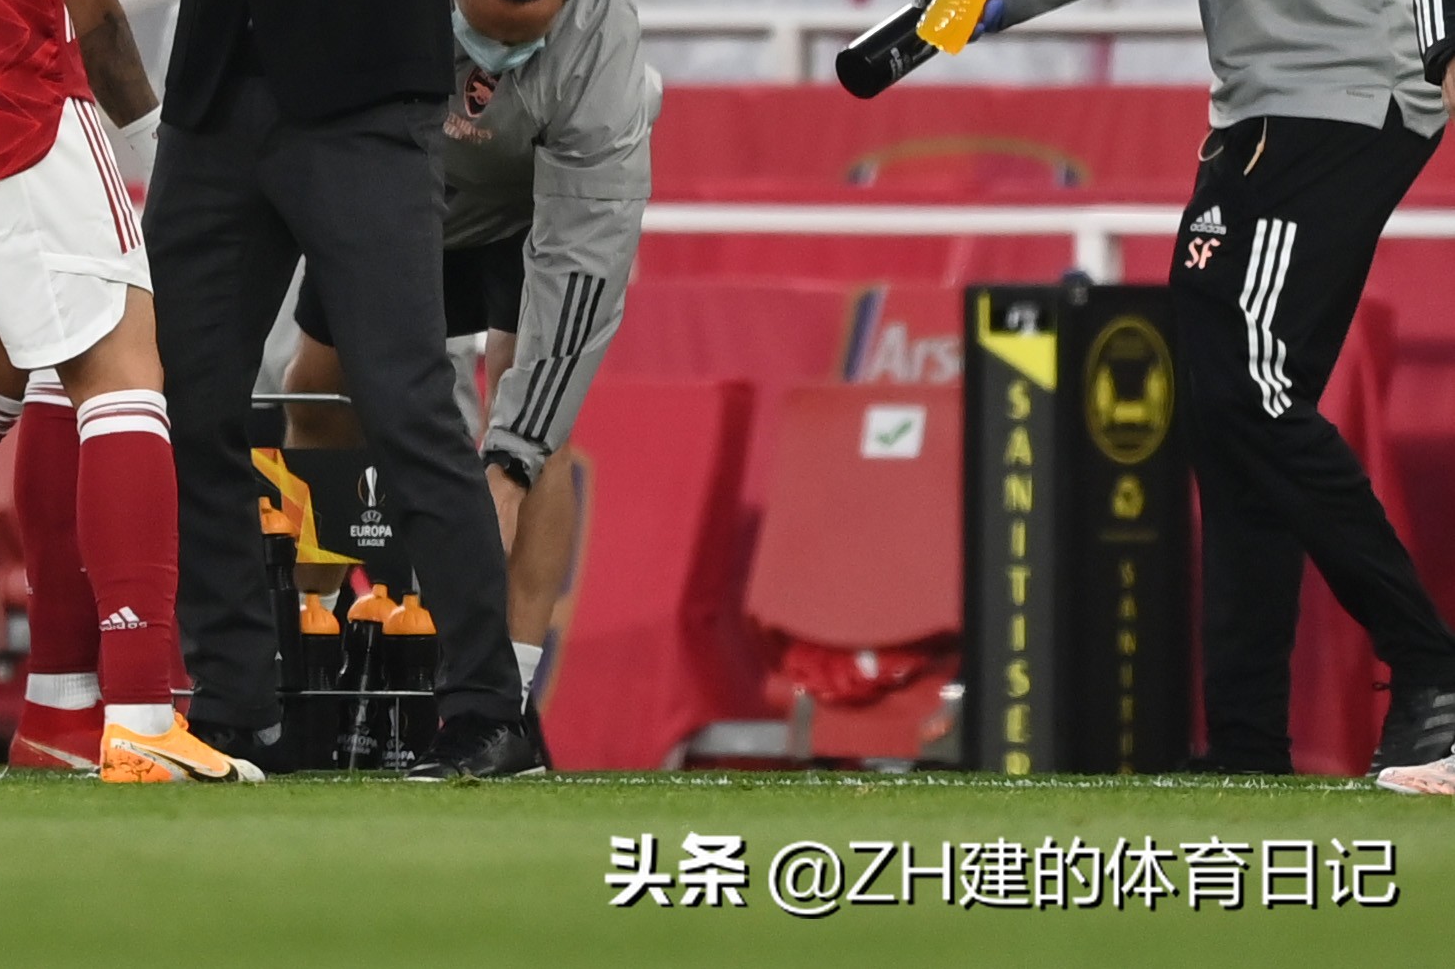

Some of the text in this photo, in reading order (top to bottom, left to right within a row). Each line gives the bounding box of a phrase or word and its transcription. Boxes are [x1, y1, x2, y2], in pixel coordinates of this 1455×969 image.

[1185, 237, 1221, 270] SF
[350, 525, 393, 538] EUROPA
[357, 538, 386, 547] LEAGUE
